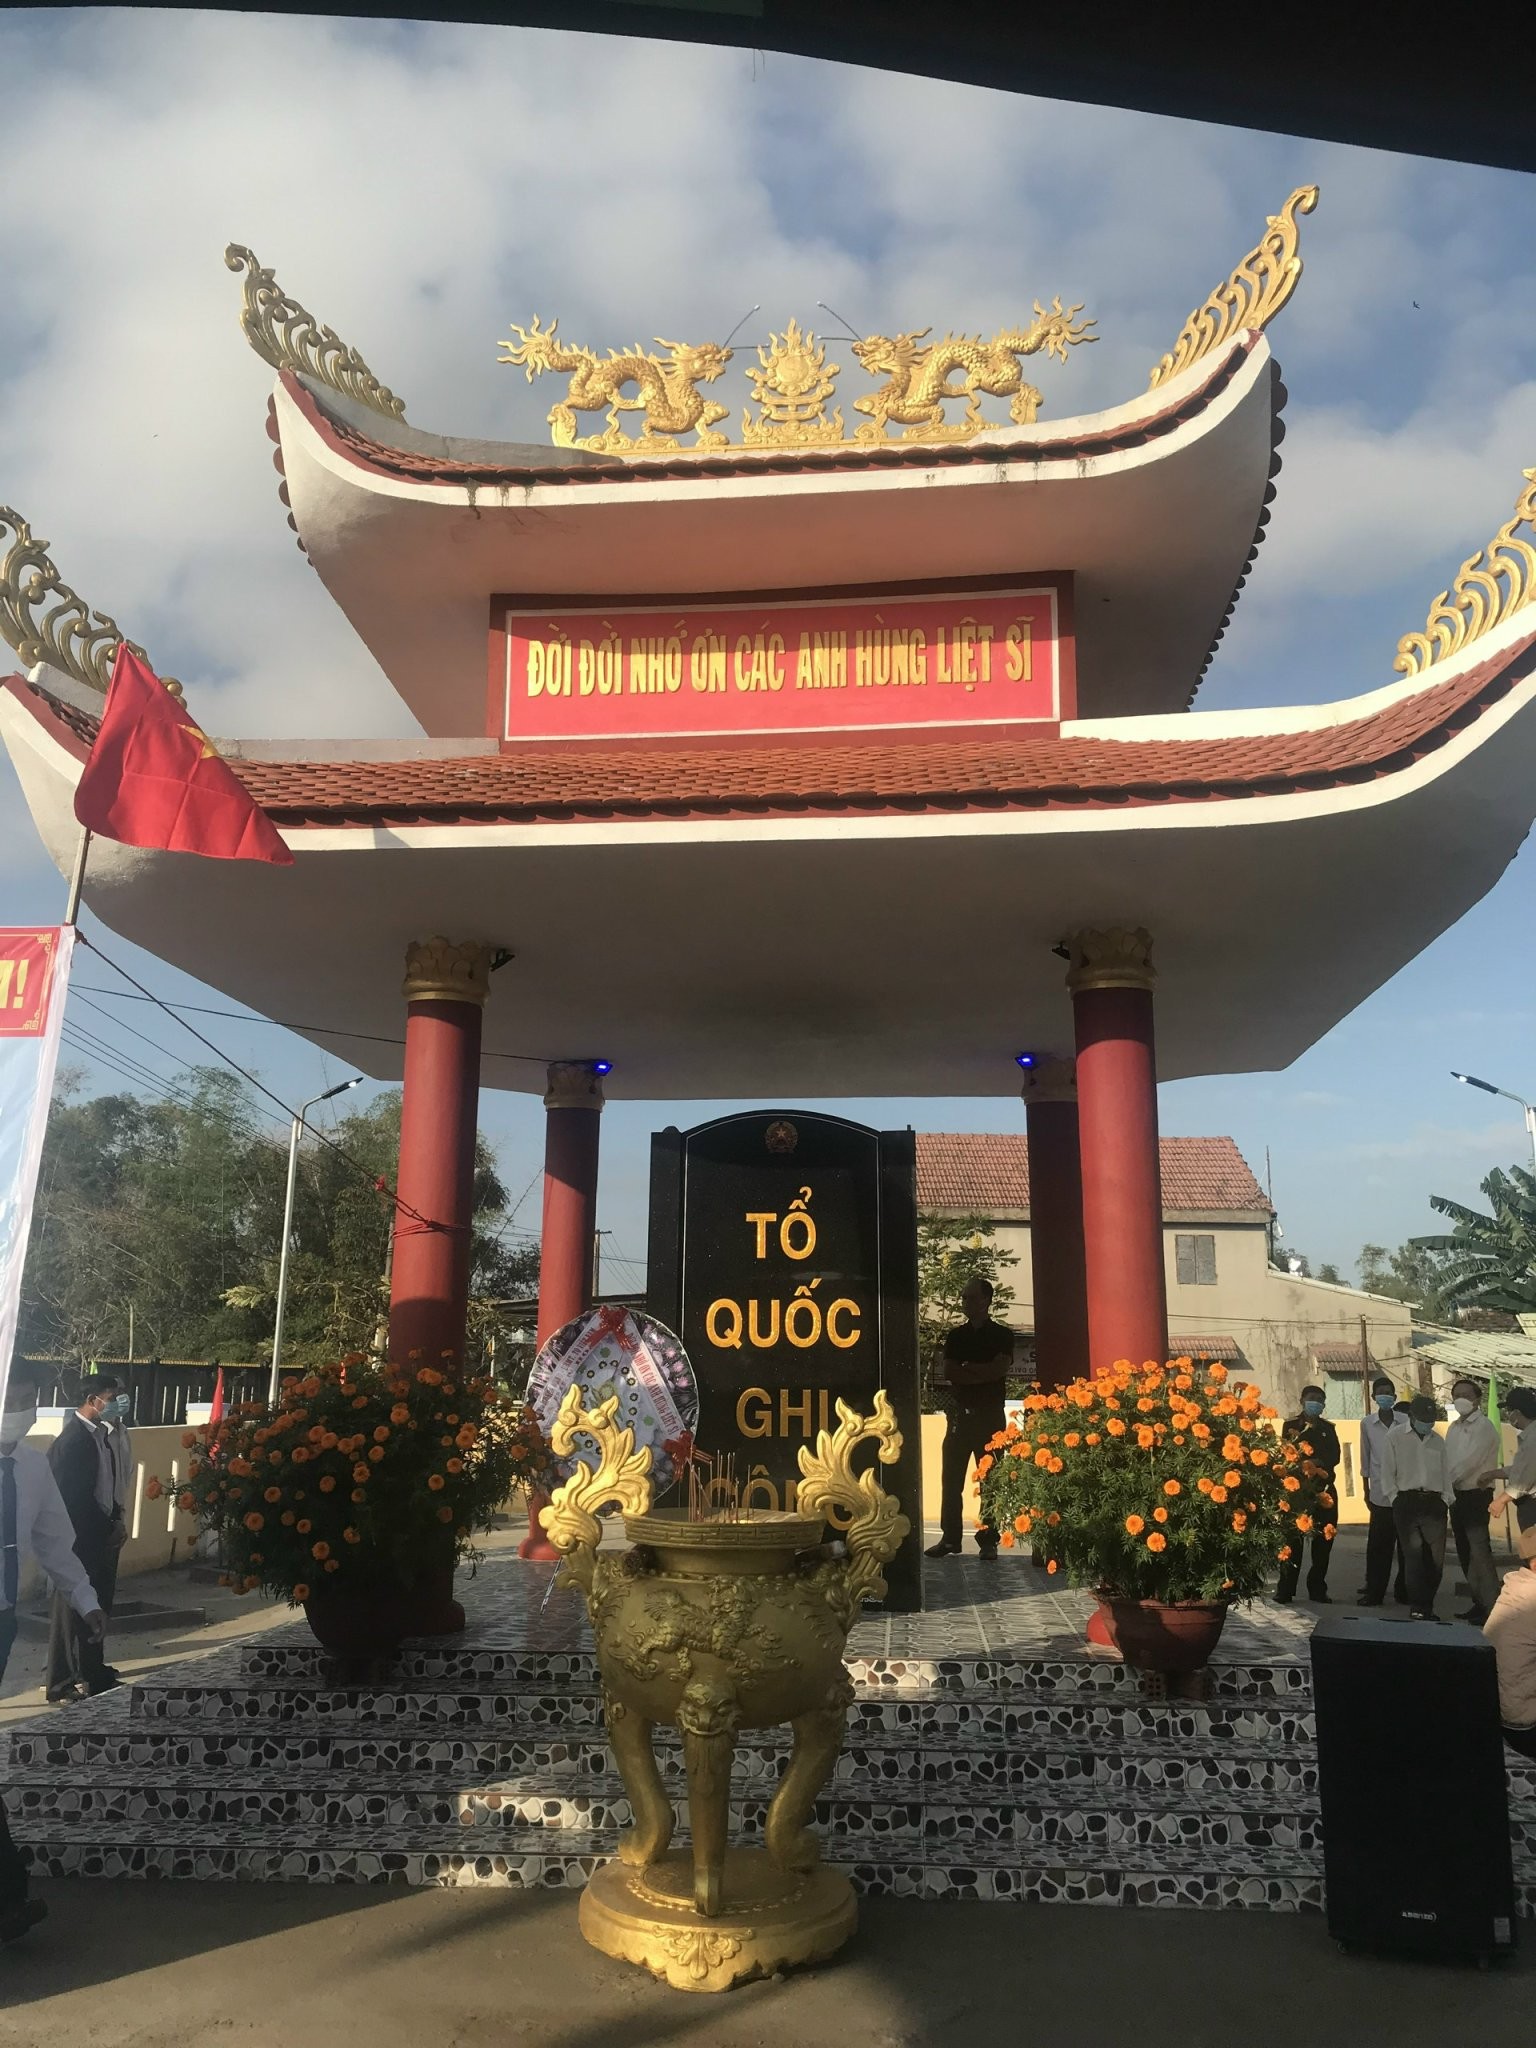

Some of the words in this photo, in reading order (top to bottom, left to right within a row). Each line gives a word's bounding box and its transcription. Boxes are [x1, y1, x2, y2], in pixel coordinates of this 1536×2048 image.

[527, 623, 572, 697] ĐỜI
[578, 620, 623, 696] ĐỜI
[629, 619, 686, 694] NHỚ
[690, 628, 727, 693] ƠN
[734, 620, 786, 692] CÁC
[795, 630, 848, 689] ANH
[855, 614, 928, 687] HÙNG
[936, 616, 994, 692] LIỆT
[1004, 616, 1035, 682] SĨ
[745, 1186, 817, 1260] TỔ
[706, 1278, 861, 1350] QUỐC
[736, 1387, 829, 1438] GHI
